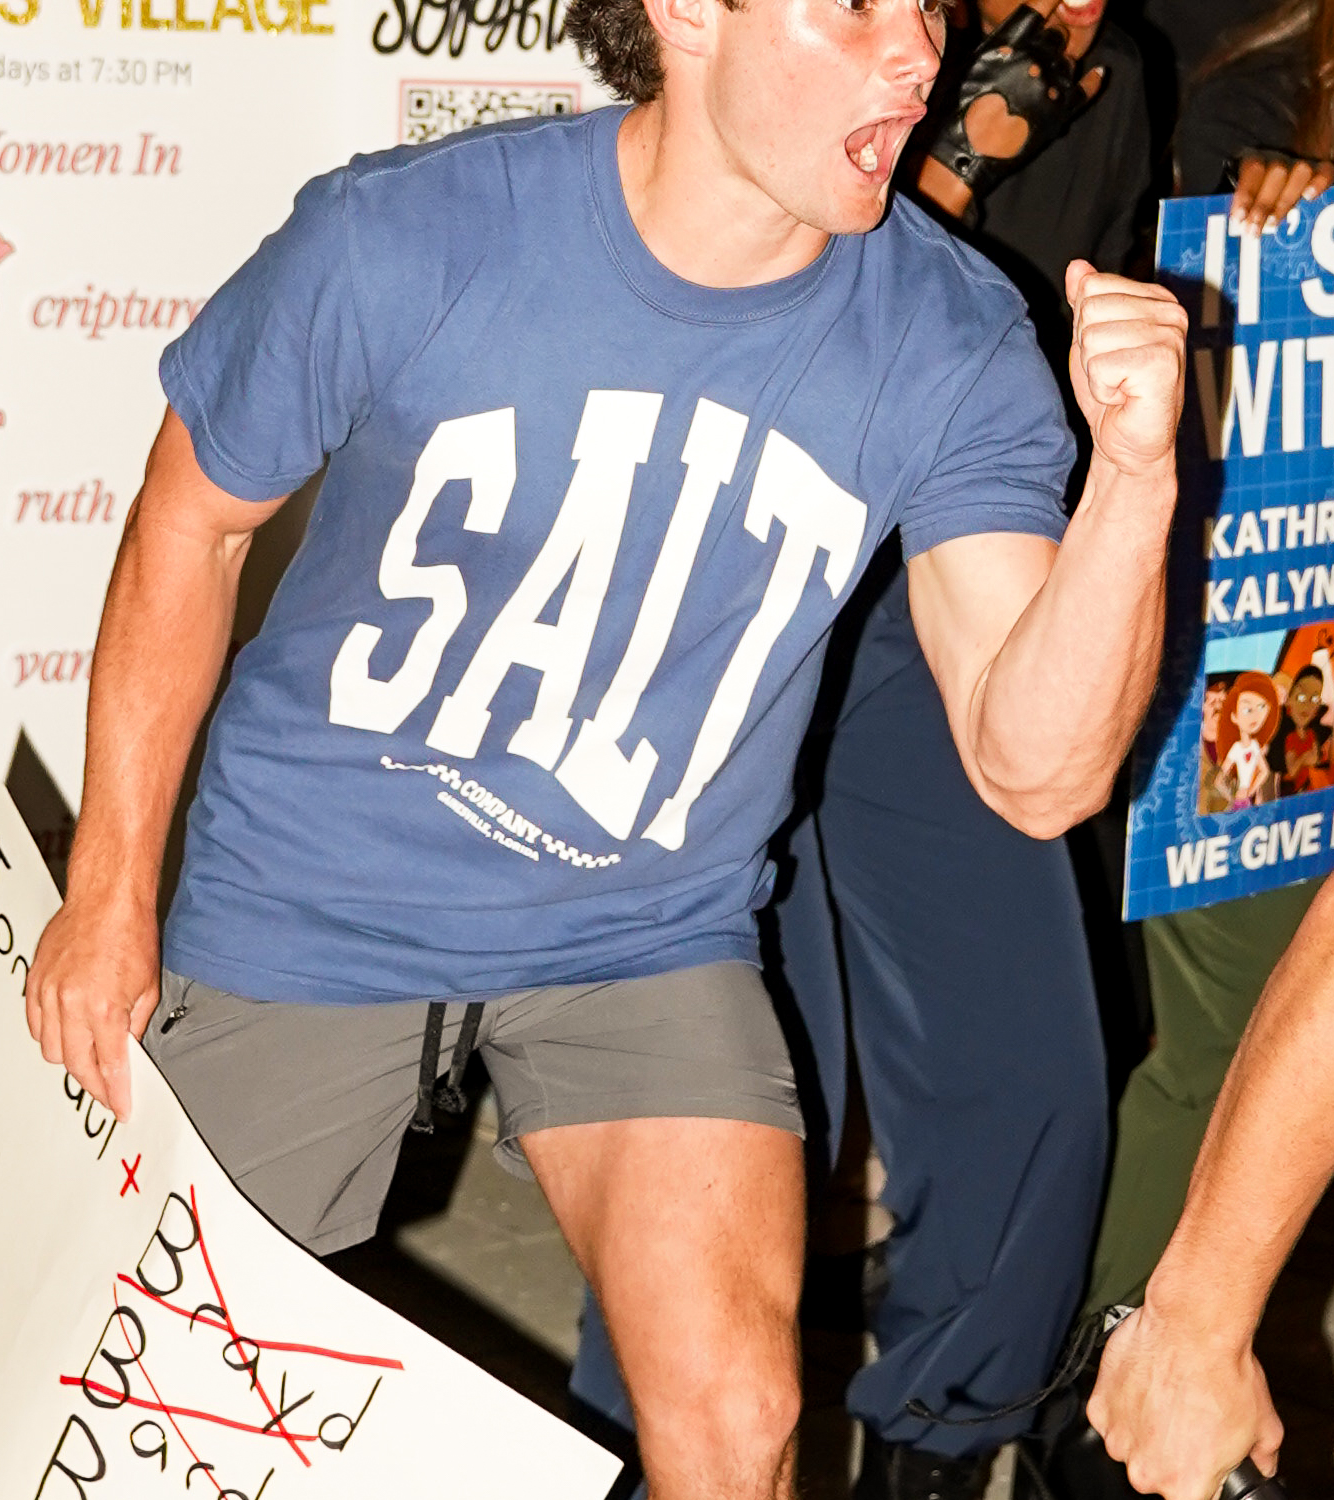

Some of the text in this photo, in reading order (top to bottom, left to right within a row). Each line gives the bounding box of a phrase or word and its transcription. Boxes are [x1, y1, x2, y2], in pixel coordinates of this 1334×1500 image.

[59, 58, 81, 81] at
[91, 58, 147, 85] 7:30
[153, 61, 193, 88] PM
[133, 132, 181, 176] In
[15, 481, 114, 525] ruth
[329, 389, 867, 851] SALT
[460, 779, 542, 844] COMPANY
[492, 830, 539, 862] FLORIDA
[1167, 834, 1229, 888] WE
[1240, 815, 1324, 871] GIVE
